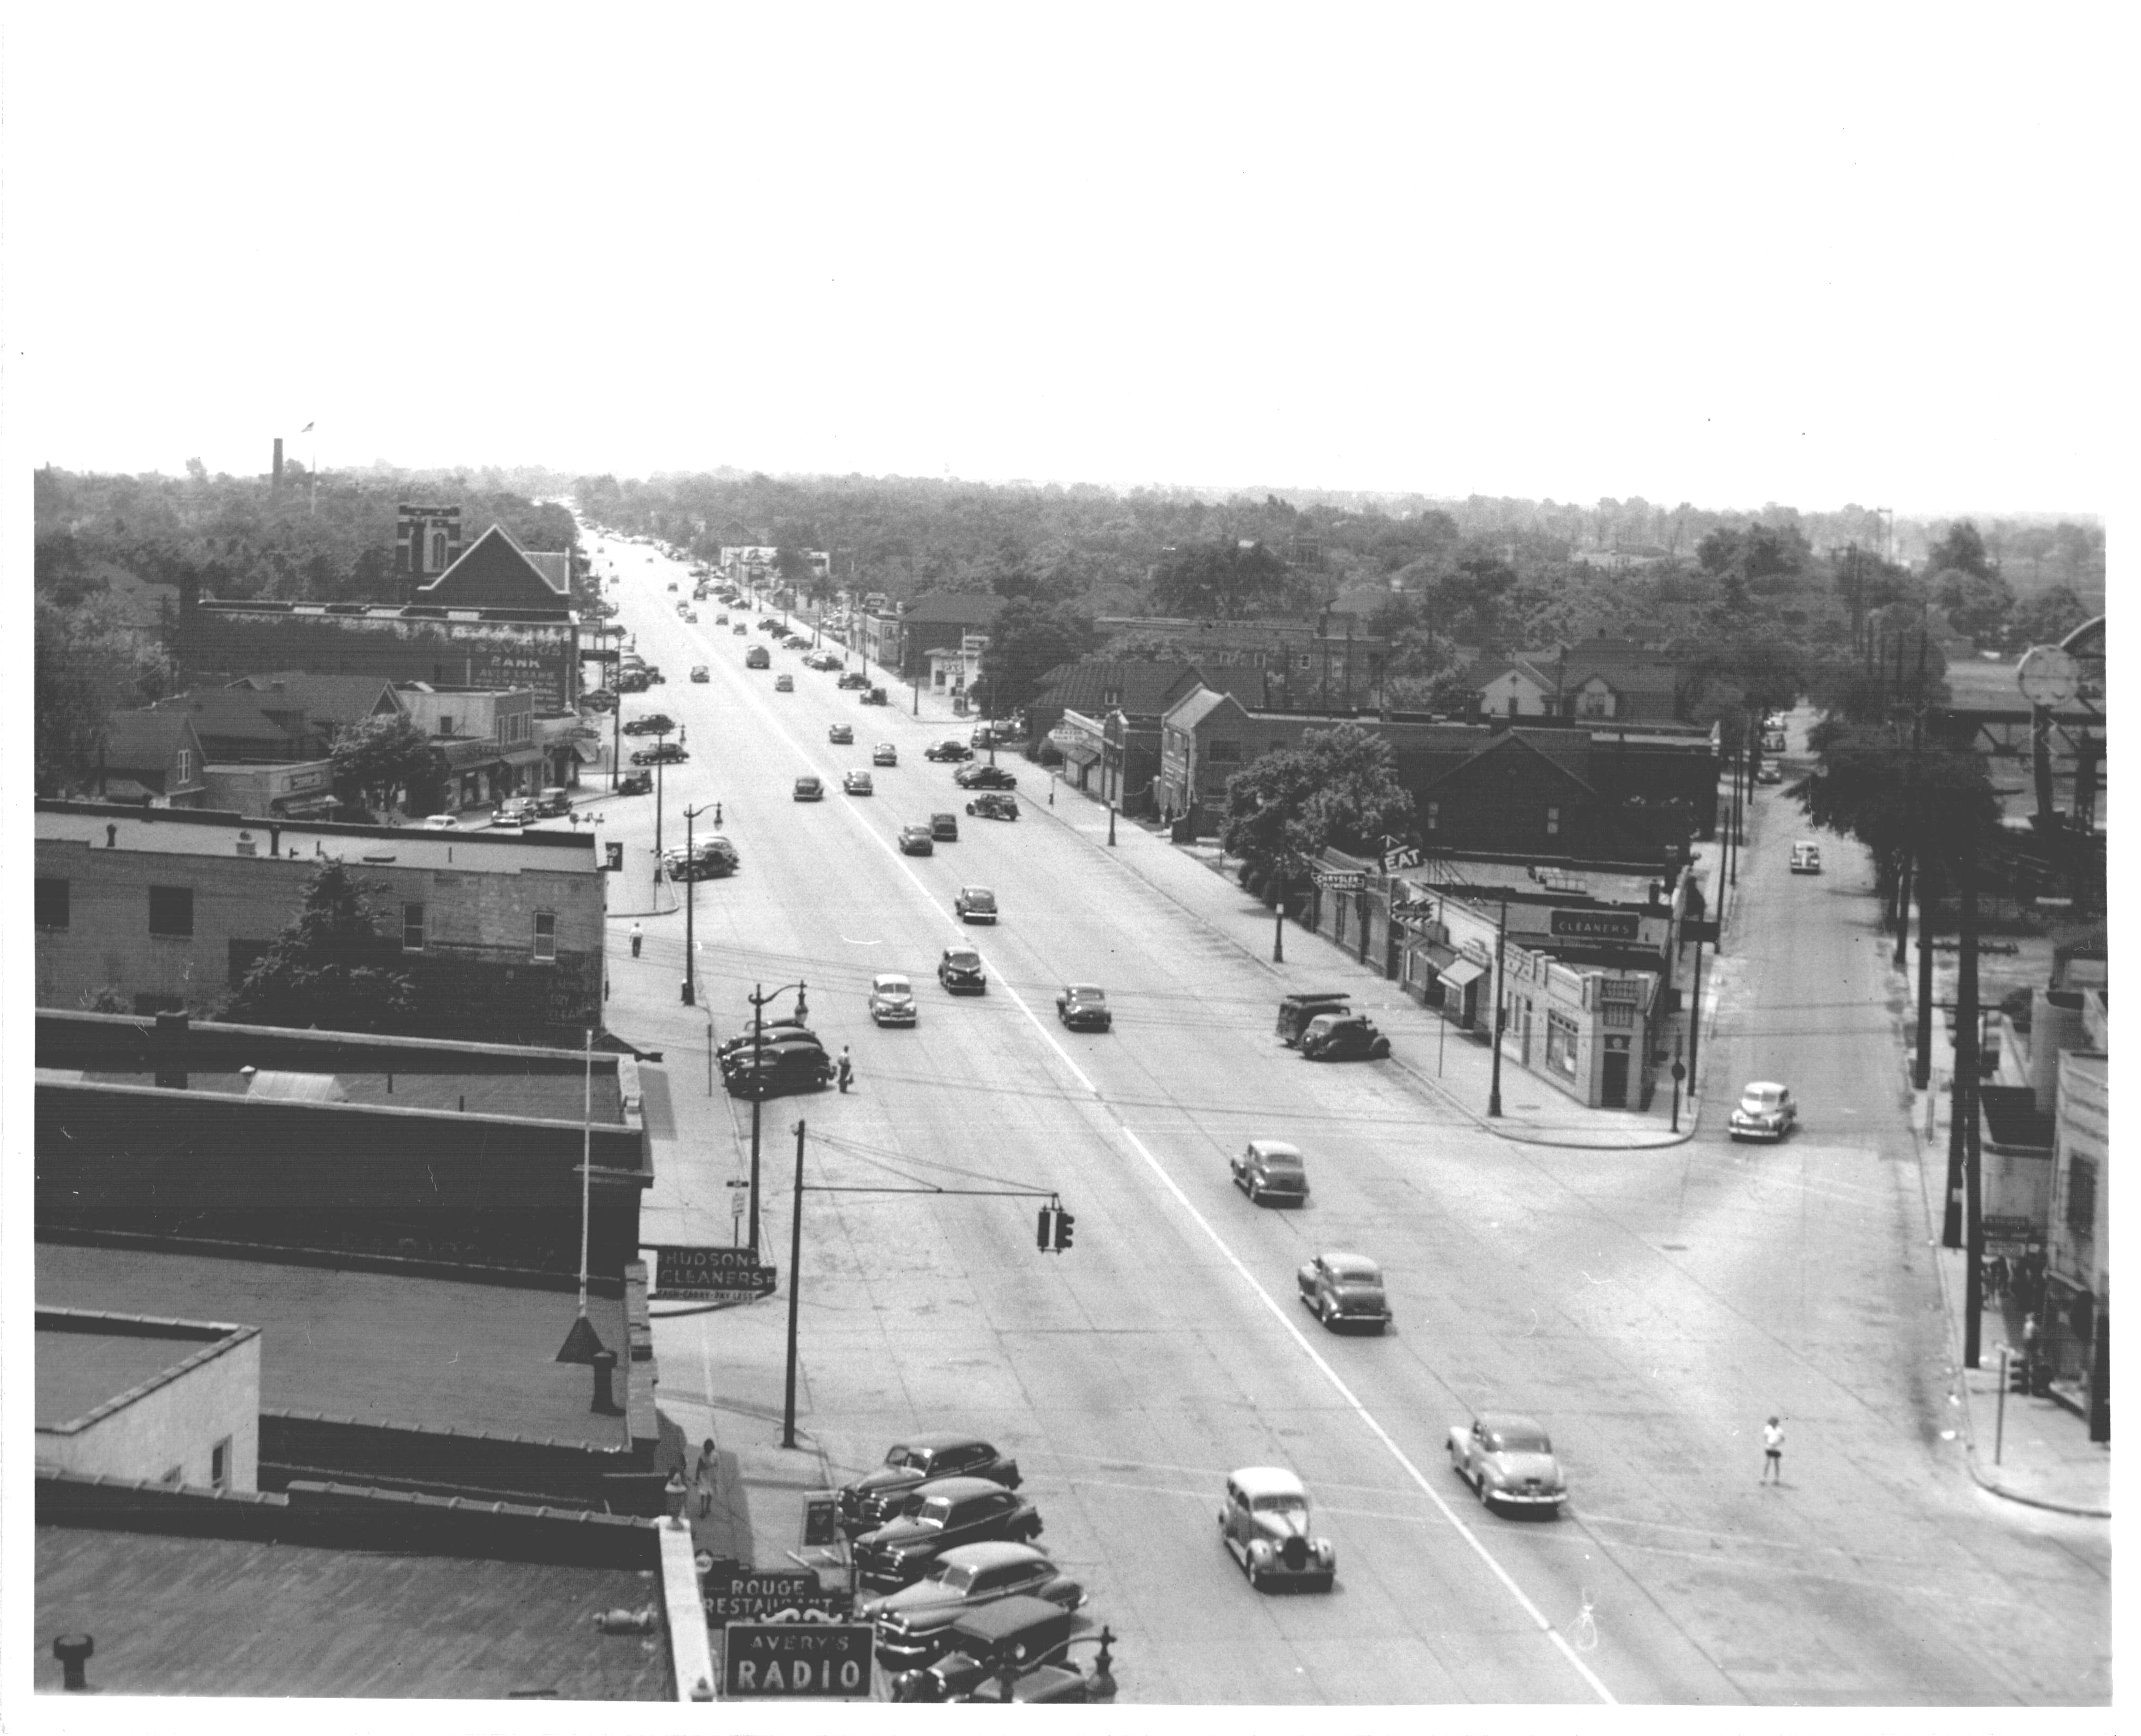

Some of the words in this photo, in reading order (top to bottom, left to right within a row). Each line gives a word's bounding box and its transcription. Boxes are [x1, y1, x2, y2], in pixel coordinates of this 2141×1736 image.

[491, 656, 540, 669] BANK
[1385, 849, 1419, 871] EAT
[1317, 875, 1359, 884] CHRYSLER
[1559, 921, 1629, 934] CLEANERS
[666, 1251, 748, 1267] HUDSON
[661, 1269, 763, 1286] CLEANERS
[731, 1579, 805, 1596] ROUGE
[752, 1635, 849, 1651] AVERY'S
[738, 1660, 860, 1690] RADIO
